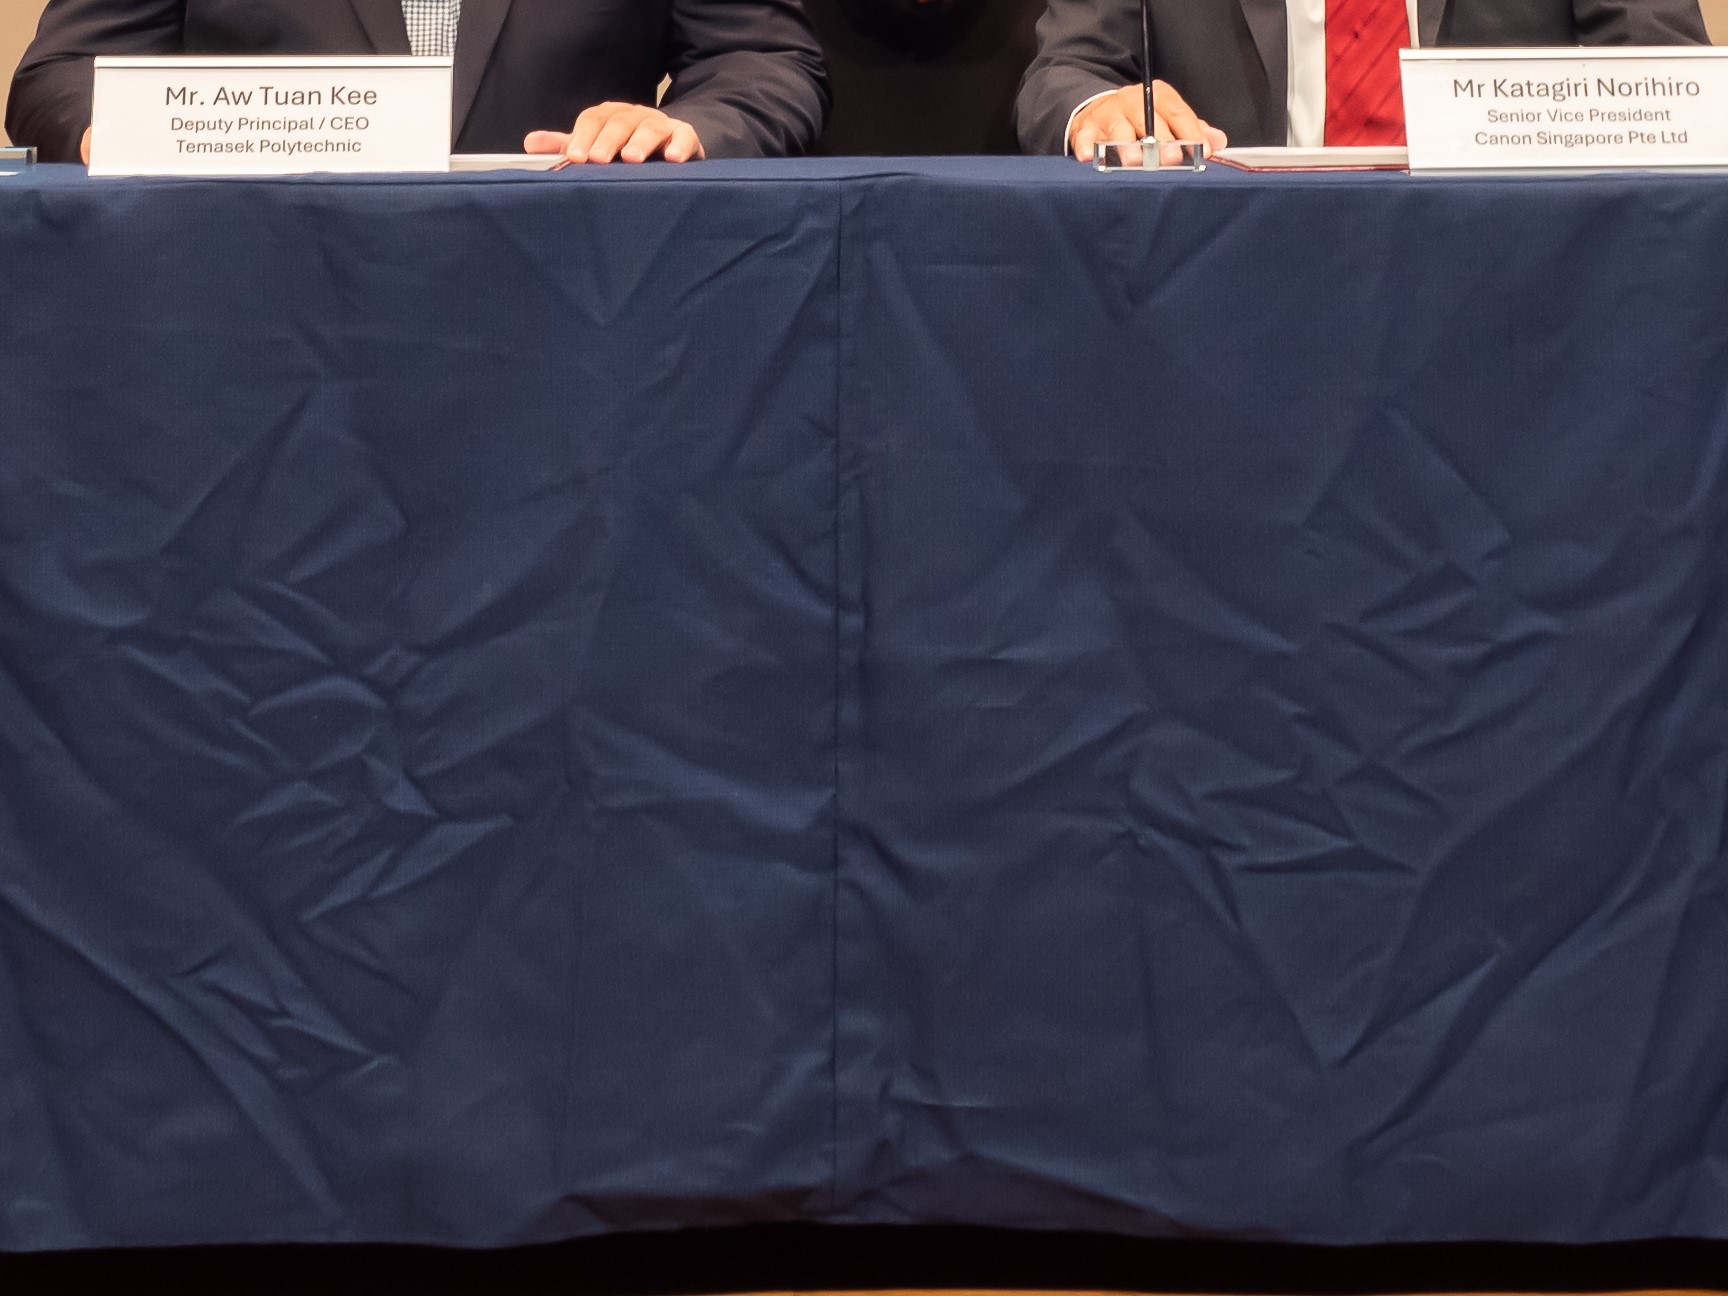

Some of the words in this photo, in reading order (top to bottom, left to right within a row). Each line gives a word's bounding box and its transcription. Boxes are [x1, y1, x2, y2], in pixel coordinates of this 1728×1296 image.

[165, 86, 205, 106] Mr.
[212, 86, 253, 106] Aw
[258, 86, 322, 106] Tuan
[331, 86, 377, 106] Kee
[1453, 78, 1486, 98] Mr
[1493, 77, 1589, 102] Katagiri
[1596, 76, 1700, 97] Norihiro
[1487, 109, 1543, 123] Senior
[1546, 108, 1584, 123] Vice
[1589, 108, 1671, 123] President
[170, 117, 234, 134] Deputy
[238, 116, 315, 134] Principal
[318, 116, 326, 131] /
[330, 116, 370, 131] CEO
[176, 139, 255, 154] Temasek
[259, 139, 362, 156] Polytechnic
[1474, 131, 1532, 146] Canon
[1536, 130, 1624, 148] Singapore
[1628, 130, 1657, 145] Pte
[1661, 129, 1688, 144] Ltd
